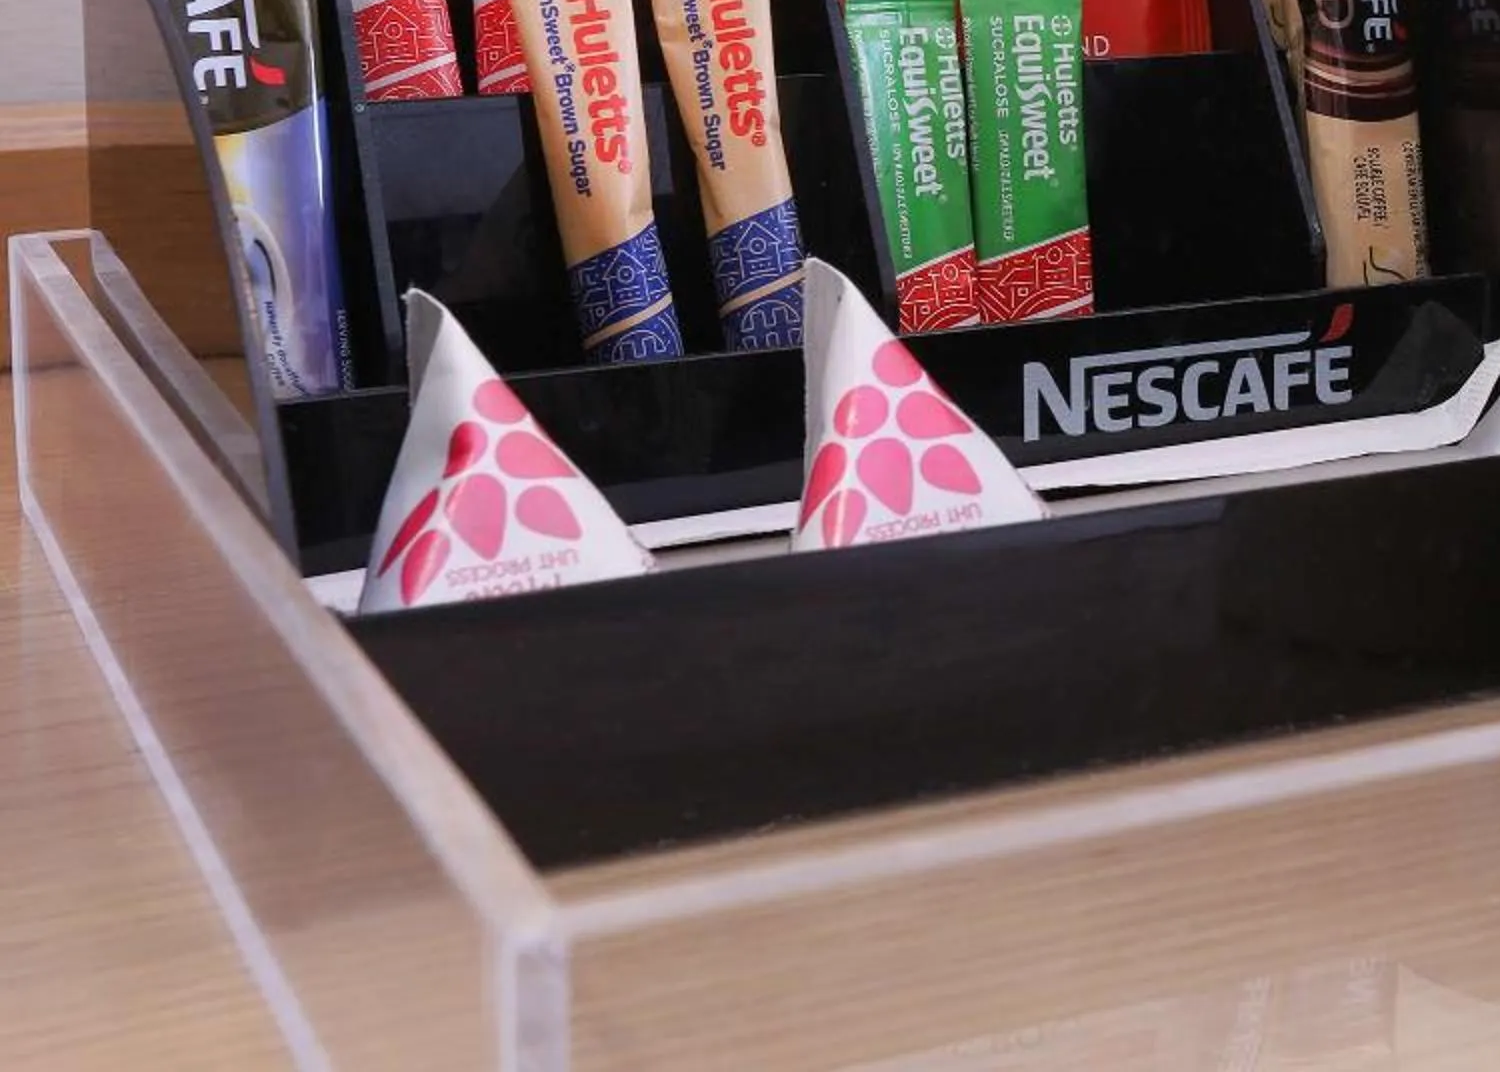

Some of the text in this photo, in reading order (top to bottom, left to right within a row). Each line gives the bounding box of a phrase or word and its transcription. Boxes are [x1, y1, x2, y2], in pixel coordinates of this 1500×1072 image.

[693, 50, 712, 110] Brown
[704, 114, 725, 170] Sugar
[878, 29, 900, 132] SUCRALOSE
[989, 15, 1009, 118] SUCRALOSE
[555, 74, 578, 136] Brown
[568, 141, 592, 197] Sugar
[445, 548, 579, 586] UHT PROCESS
[865, 503, 981, 541] UHT PROCESS
